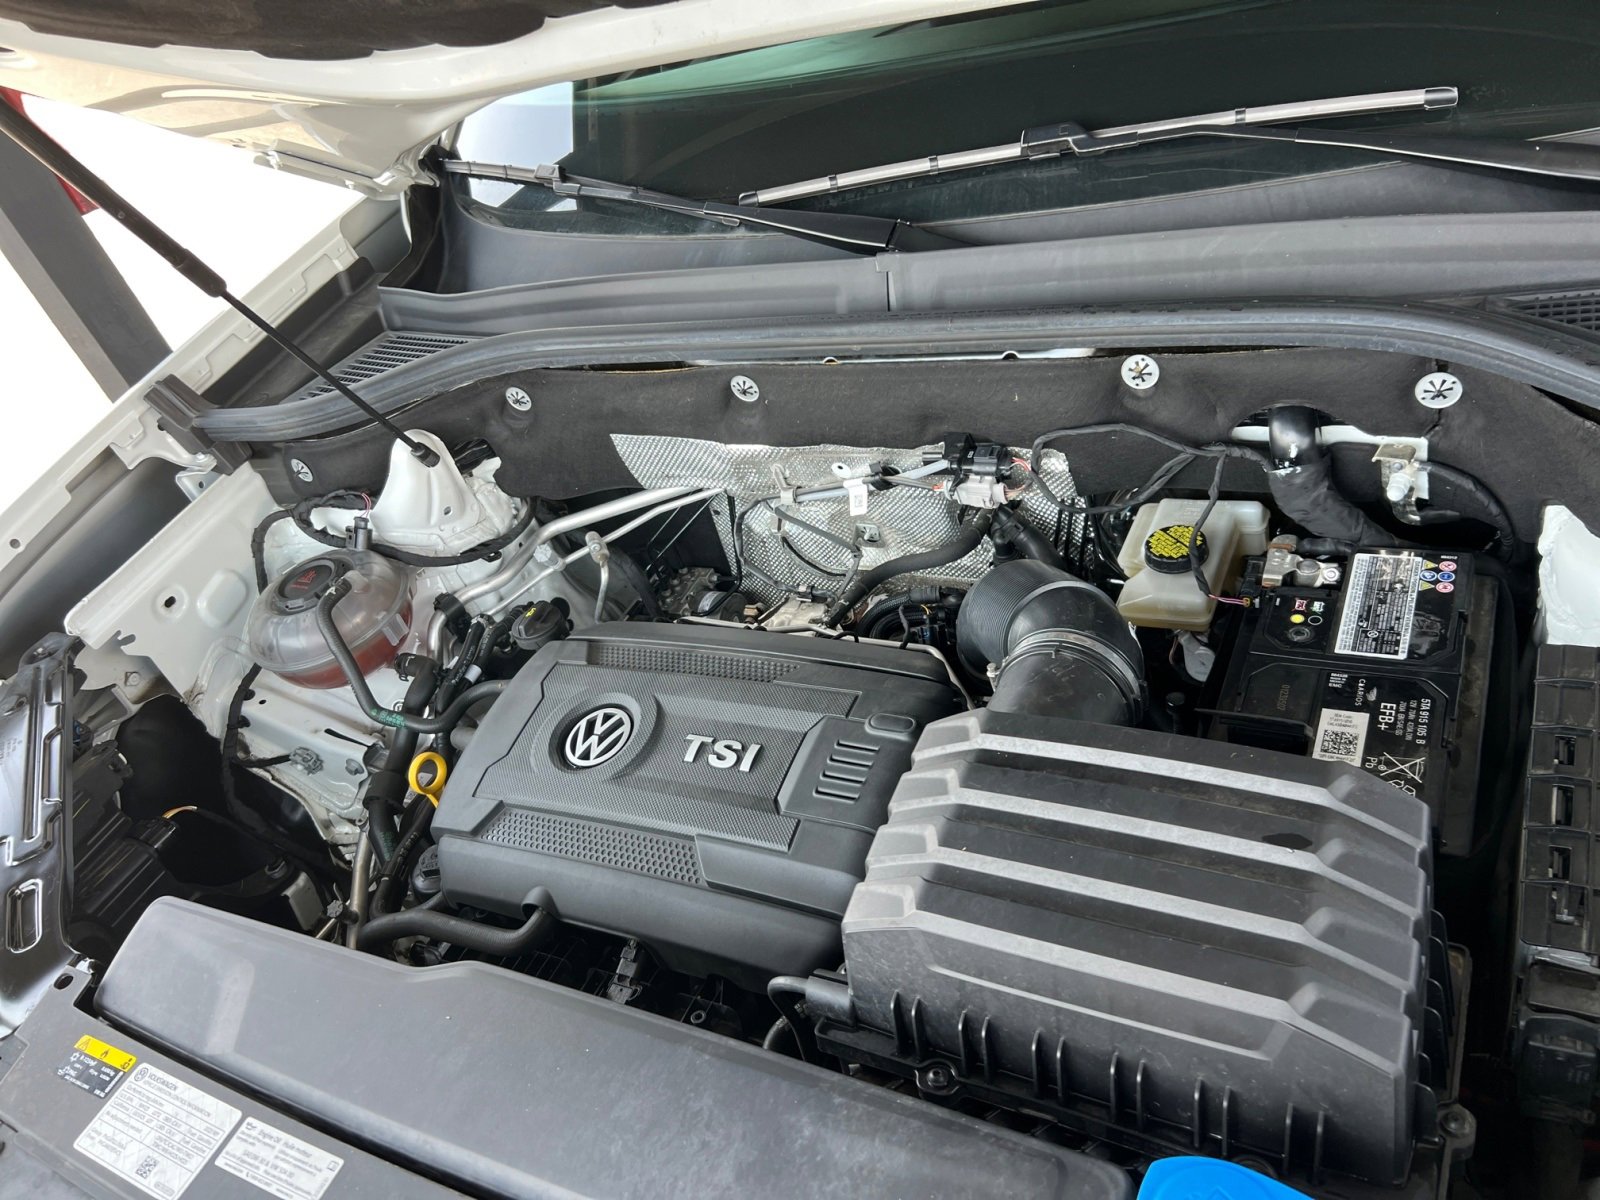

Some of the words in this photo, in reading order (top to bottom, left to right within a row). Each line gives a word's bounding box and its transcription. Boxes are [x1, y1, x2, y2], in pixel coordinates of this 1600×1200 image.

[1421, 698, 1431, 710] 5TA
[1377, 702, 1396, 730] EFB+
[1419, 711, 1430, 723] 915
[1416, 725, 1427, 736] 105
[683, 733, 762, 772] TSI
[1365, 757, 1378, 768] Pb
[146, 1072, 179, 1091] VOLKSWAGEN
